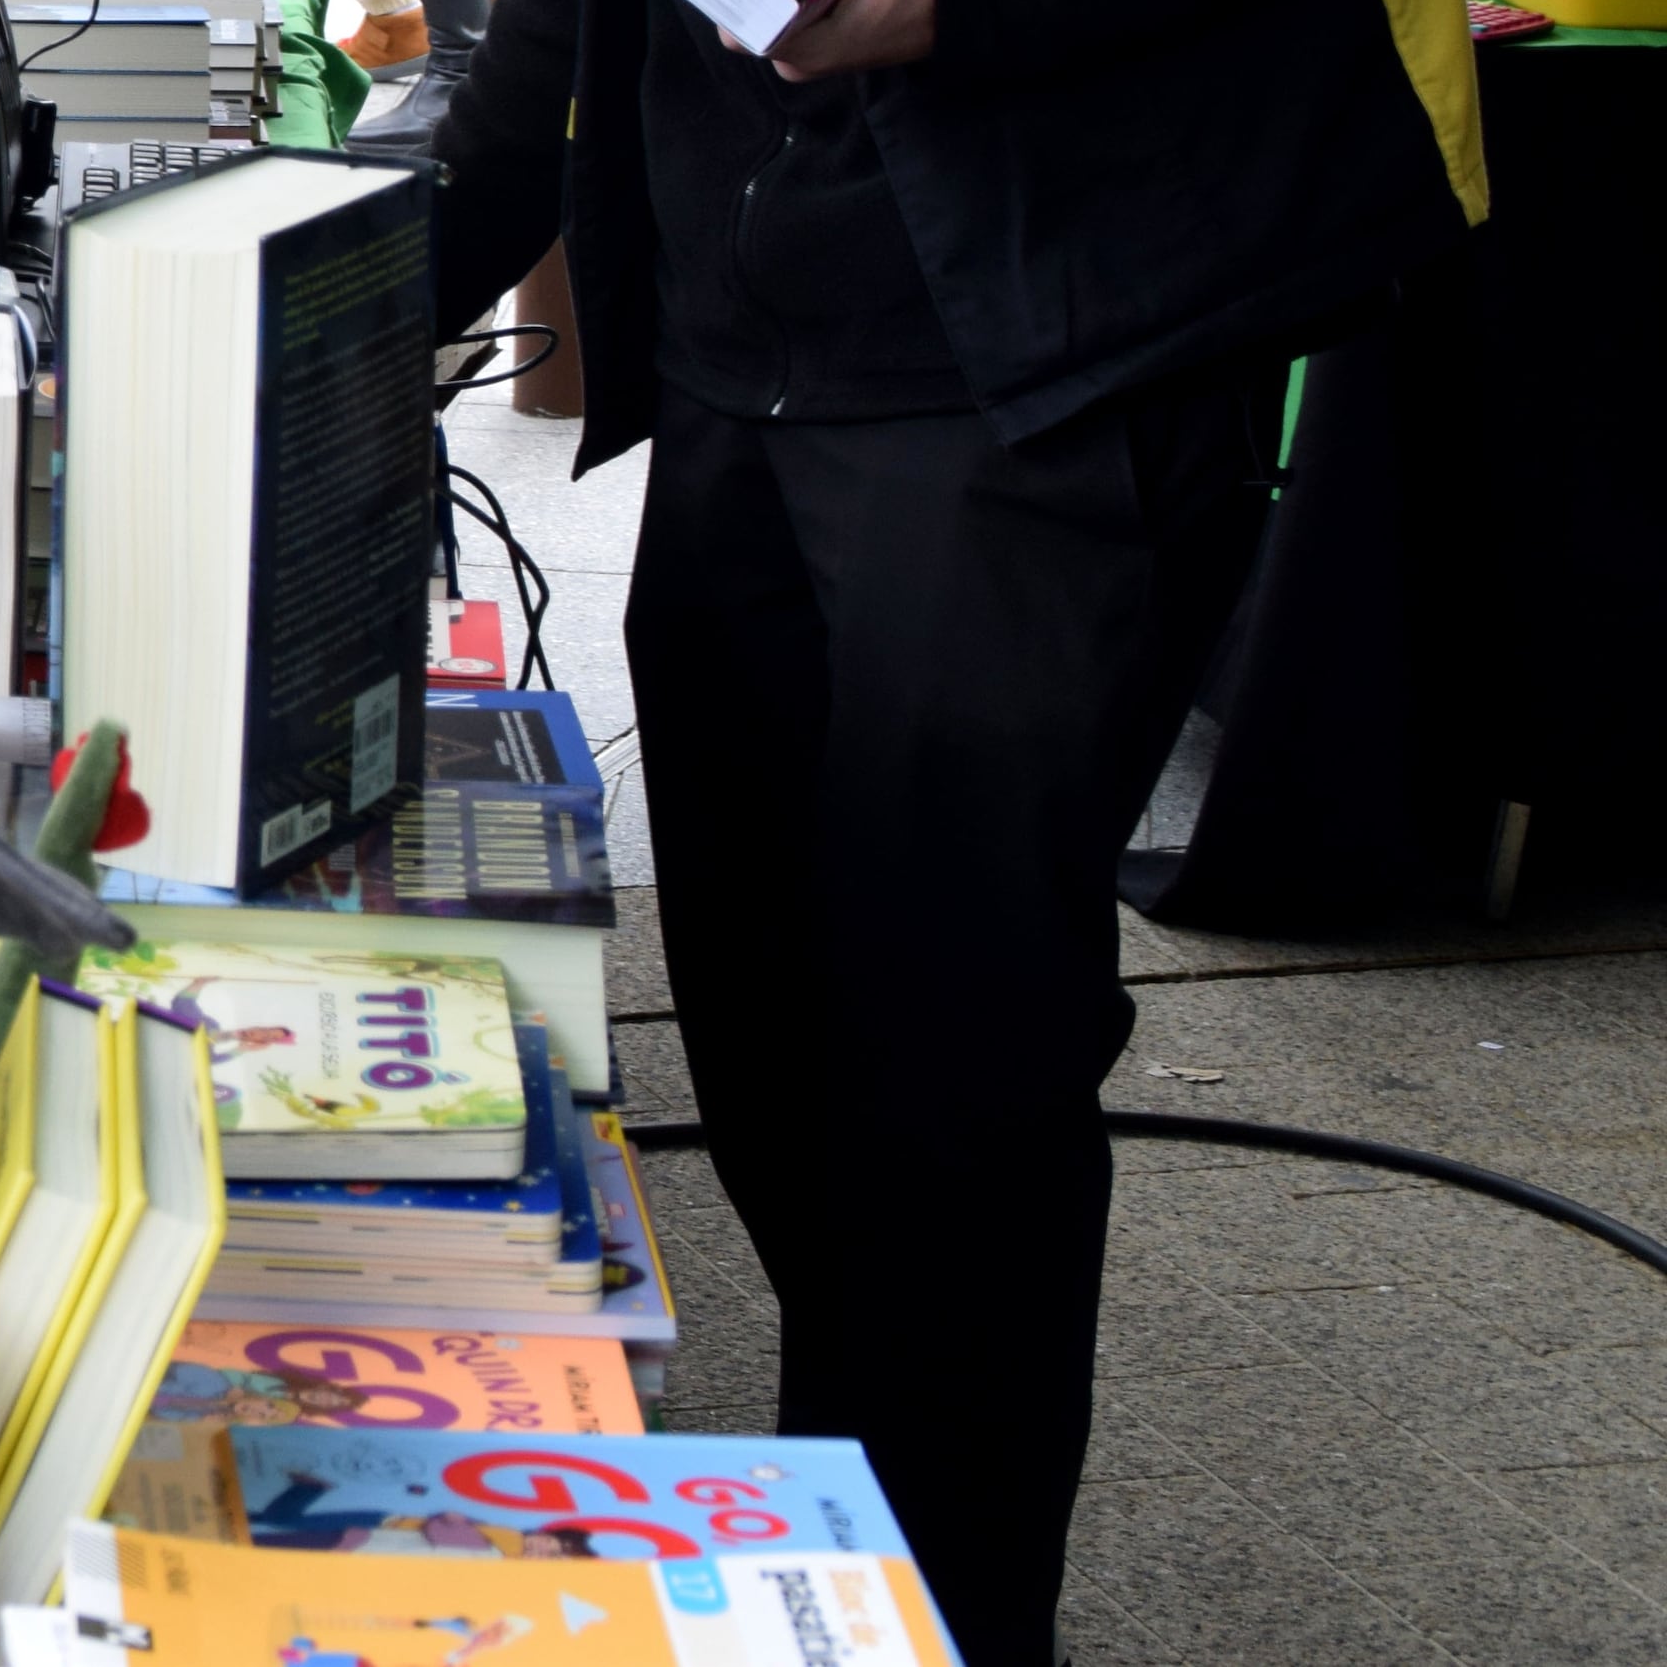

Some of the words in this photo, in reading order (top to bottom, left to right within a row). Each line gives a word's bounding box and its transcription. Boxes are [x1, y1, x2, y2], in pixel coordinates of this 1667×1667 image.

[473, 800, 552, 890] BRANDON
[357, 986, 435, 1092] TITO
[432, 1334, 532, 1394] QUIN
